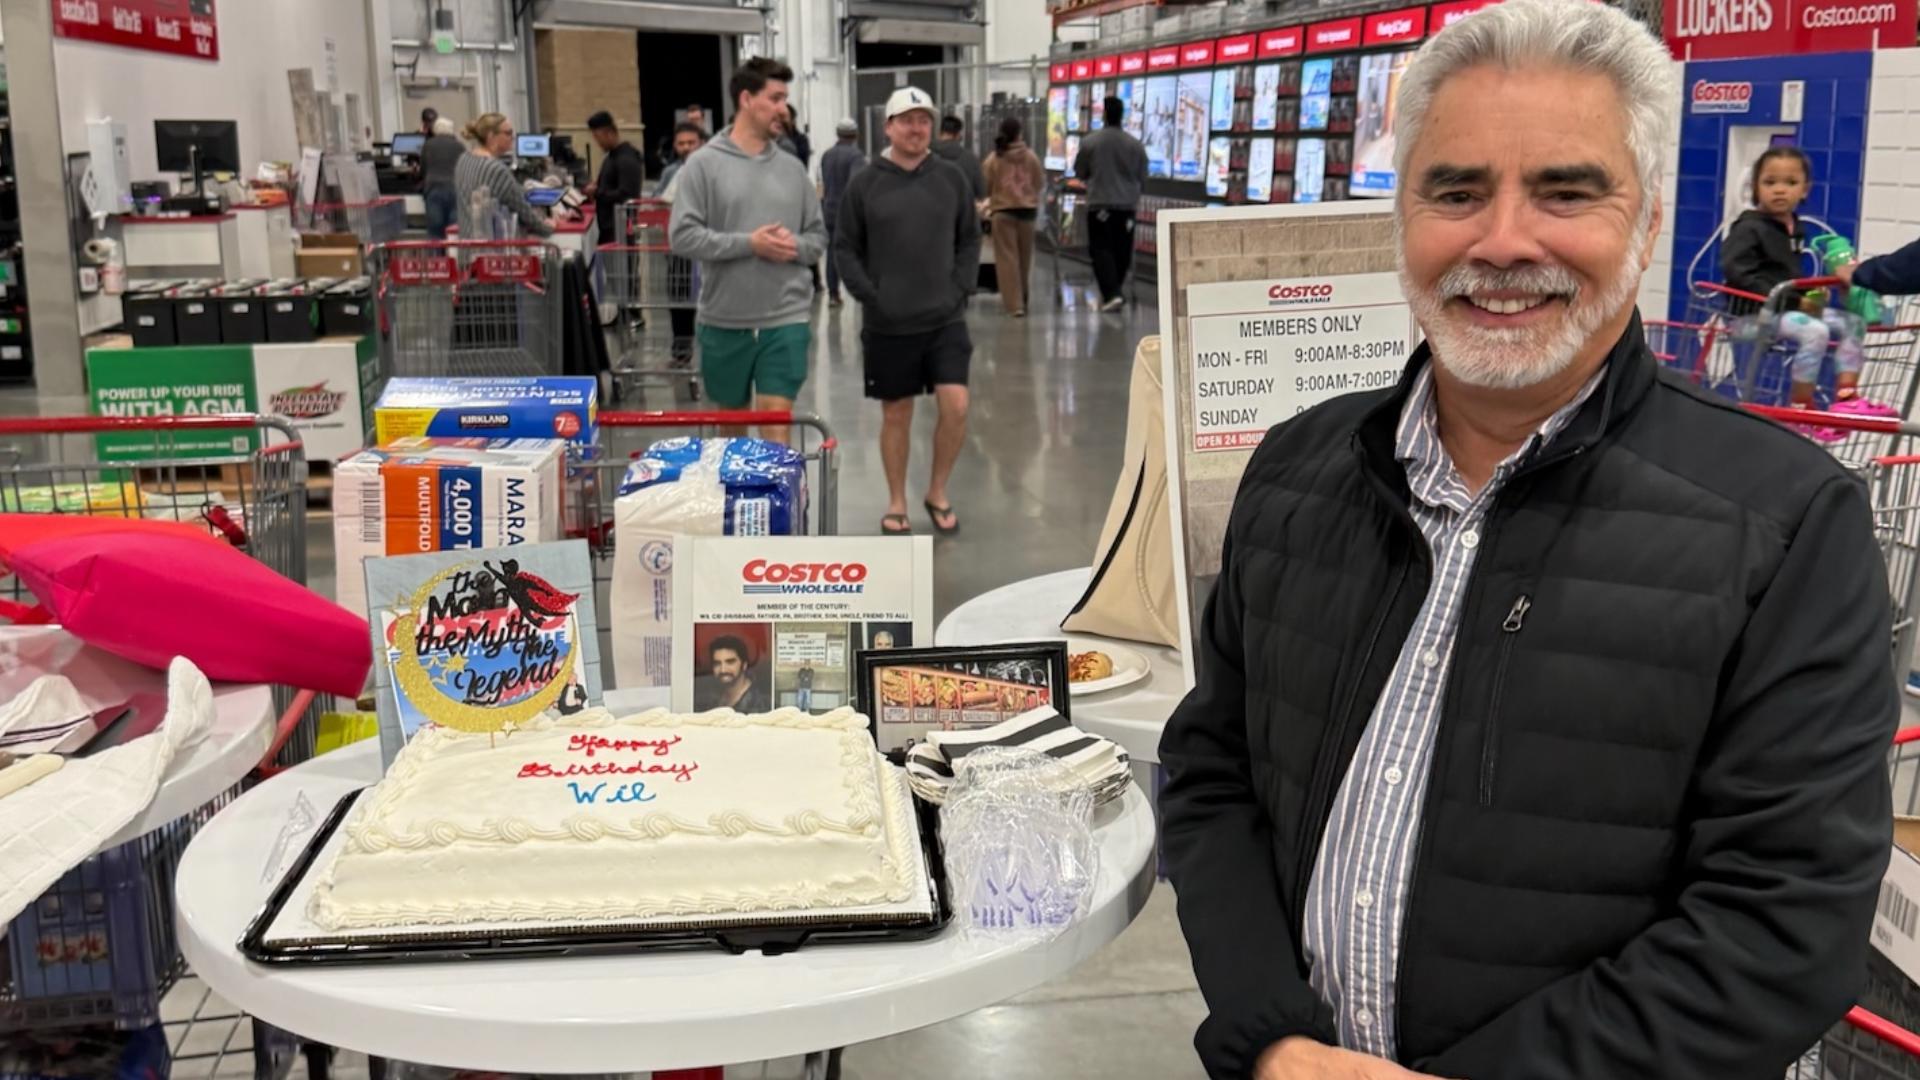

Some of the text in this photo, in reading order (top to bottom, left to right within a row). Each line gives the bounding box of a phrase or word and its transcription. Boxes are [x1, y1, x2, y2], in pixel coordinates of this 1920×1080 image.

[1676, 0, 1896, 37] LOCKERS Costco.com
[1694, 82, 1751, 101] COSTCO
[1268, 285, 1333, 298] COSTCO
[1239, 315, 1362, 338] MEMBERS ONLY
[1197, 351, 1232, 368] MON
[1244, 349, 1268, 366] FRI
[1294, 340, 1405, 363] 9:00AM-8:30PM
[97, 384, 245, 400] POWER UP YOUR RIDE
[1198, 378, 1275, 398] SATURDAY
[100, 398, 247, 417] WITH AGM
[1199, 407, 1259, 427] SUNDAY
[460, 415, 509, 425] KIRKLAND
[555, 416, 566, 432] 7
[1197, 435, 1222, 447] OPEN
[1224, 434, 1238, 446] 24
[418, 476, 431, 552] MULTIFOLD
[450, 478, 472, 536] 4,000
[506, 478, 526, 546] MARA
[742, 559, 867, 583] COSTCO
[781, 584, 864, 594] WHOLESALE
[567, 734, 683, 757] Happy
[517, 759, 700, 782] Birthday
[567, 782, 657, 804] Wil
